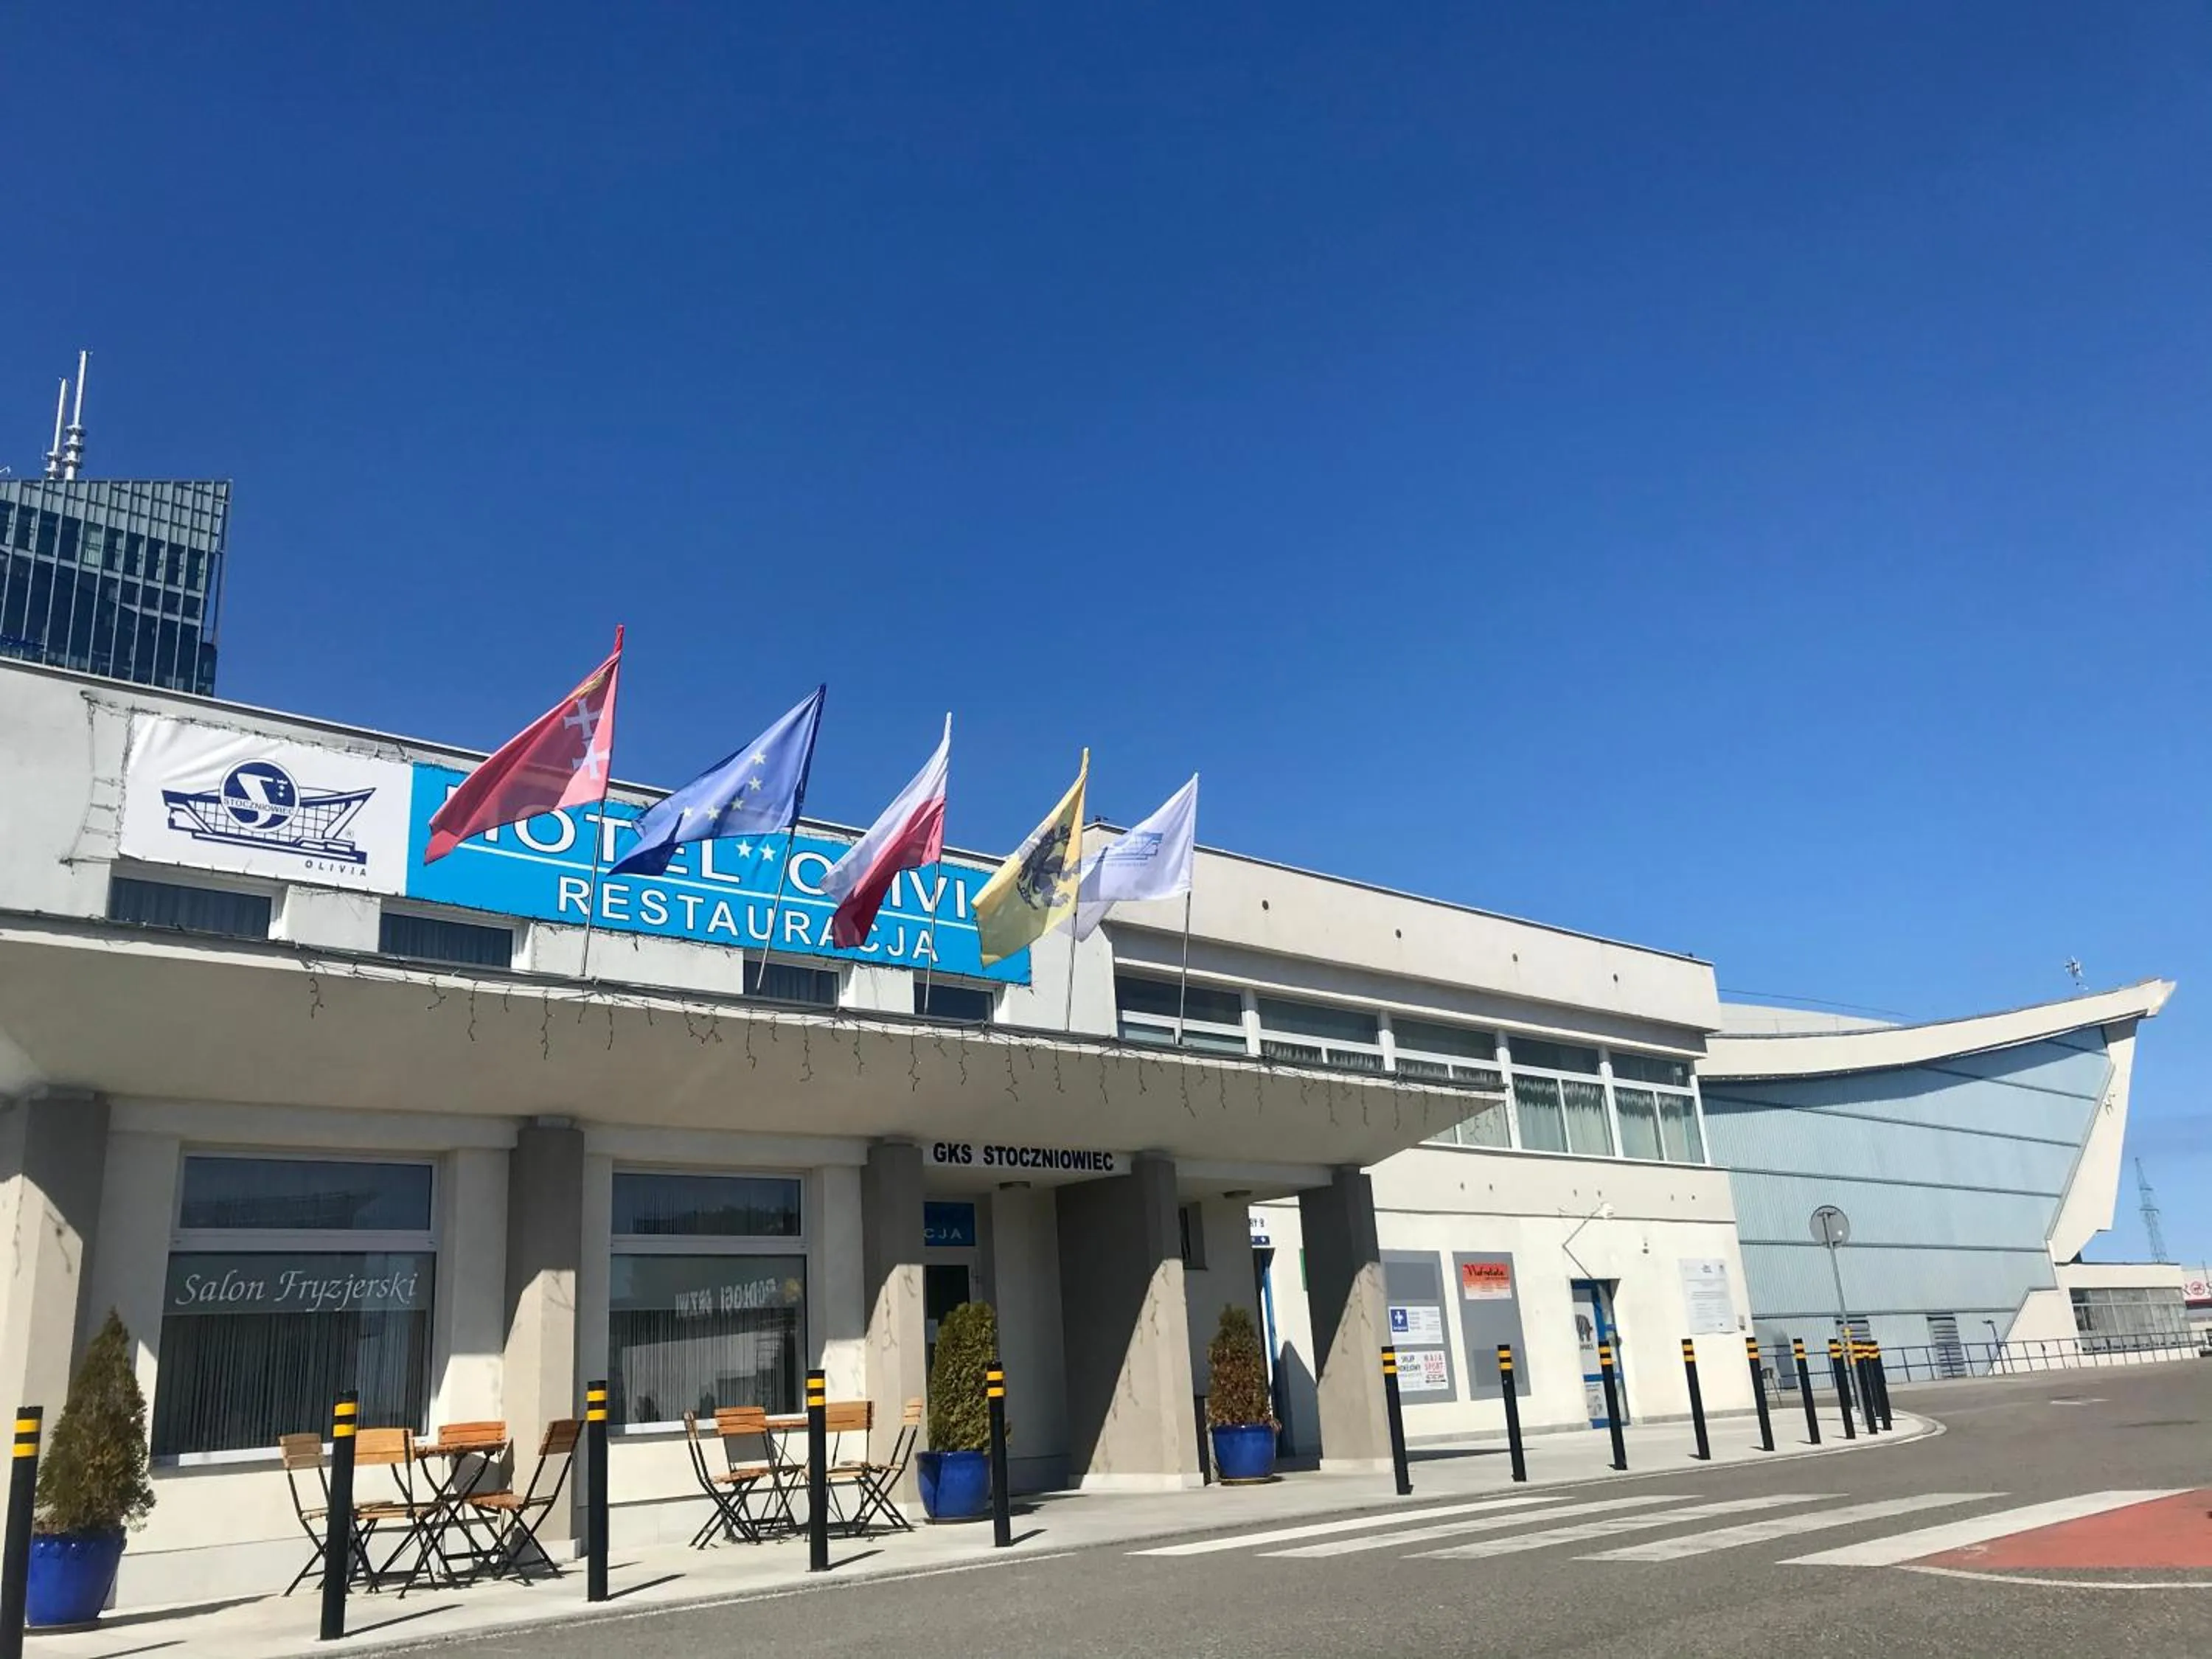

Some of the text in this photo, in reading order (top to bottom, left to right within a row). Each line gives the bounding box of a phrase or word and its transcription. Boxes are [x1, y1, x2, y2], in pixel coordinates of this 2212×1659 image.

[223, 798, 293, 816] STOCZNIOWIEC
[305, 860, 366, 877] OLIVIA
[933, 1142, 1114, 1172] GKS STOCZNIOWIEC
[175, 1269, 419, 1312] Salon Fryzjerski
